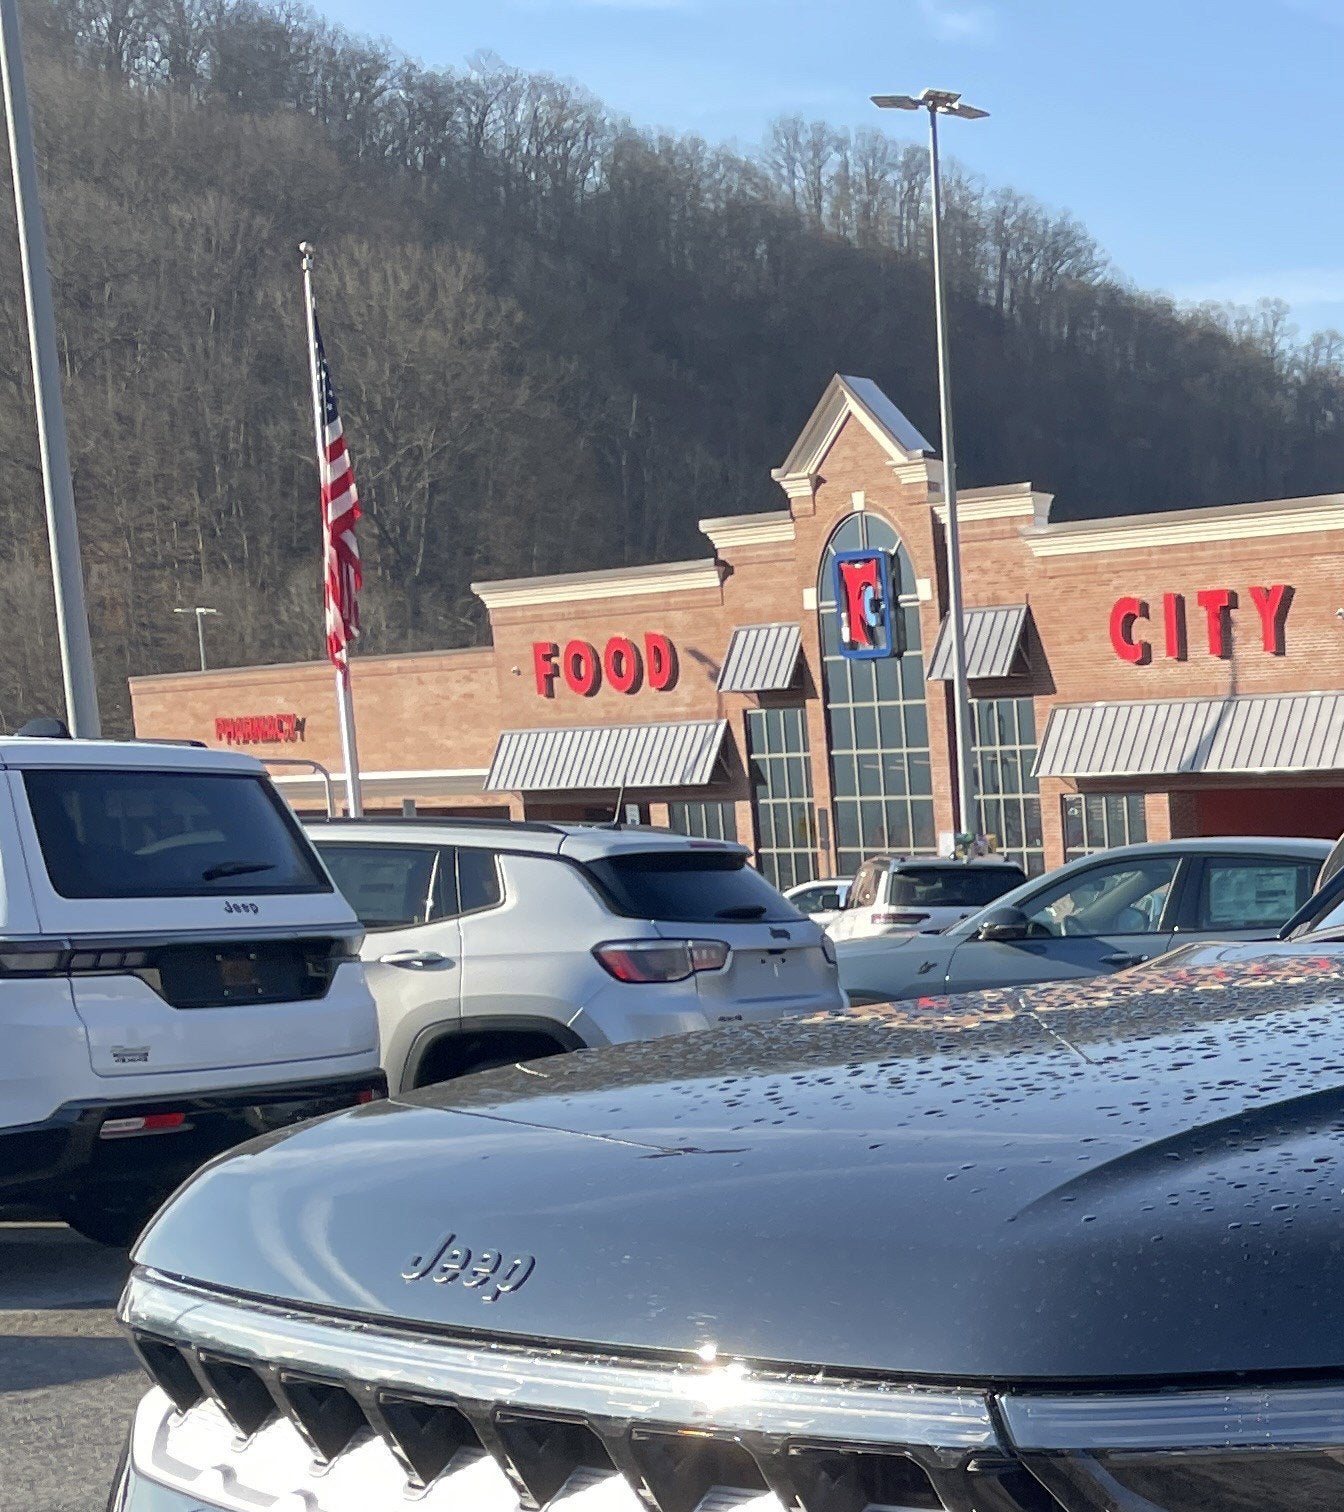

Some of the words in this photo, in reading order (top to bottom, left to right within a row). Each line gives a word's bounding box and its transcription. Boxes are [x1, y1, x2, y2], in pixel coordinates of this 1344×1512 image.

[533, 631, 679, 698] FOOD
[1110, 584, 1295, 665] CITY
[402, 1234, 536, 1303] Jeep
